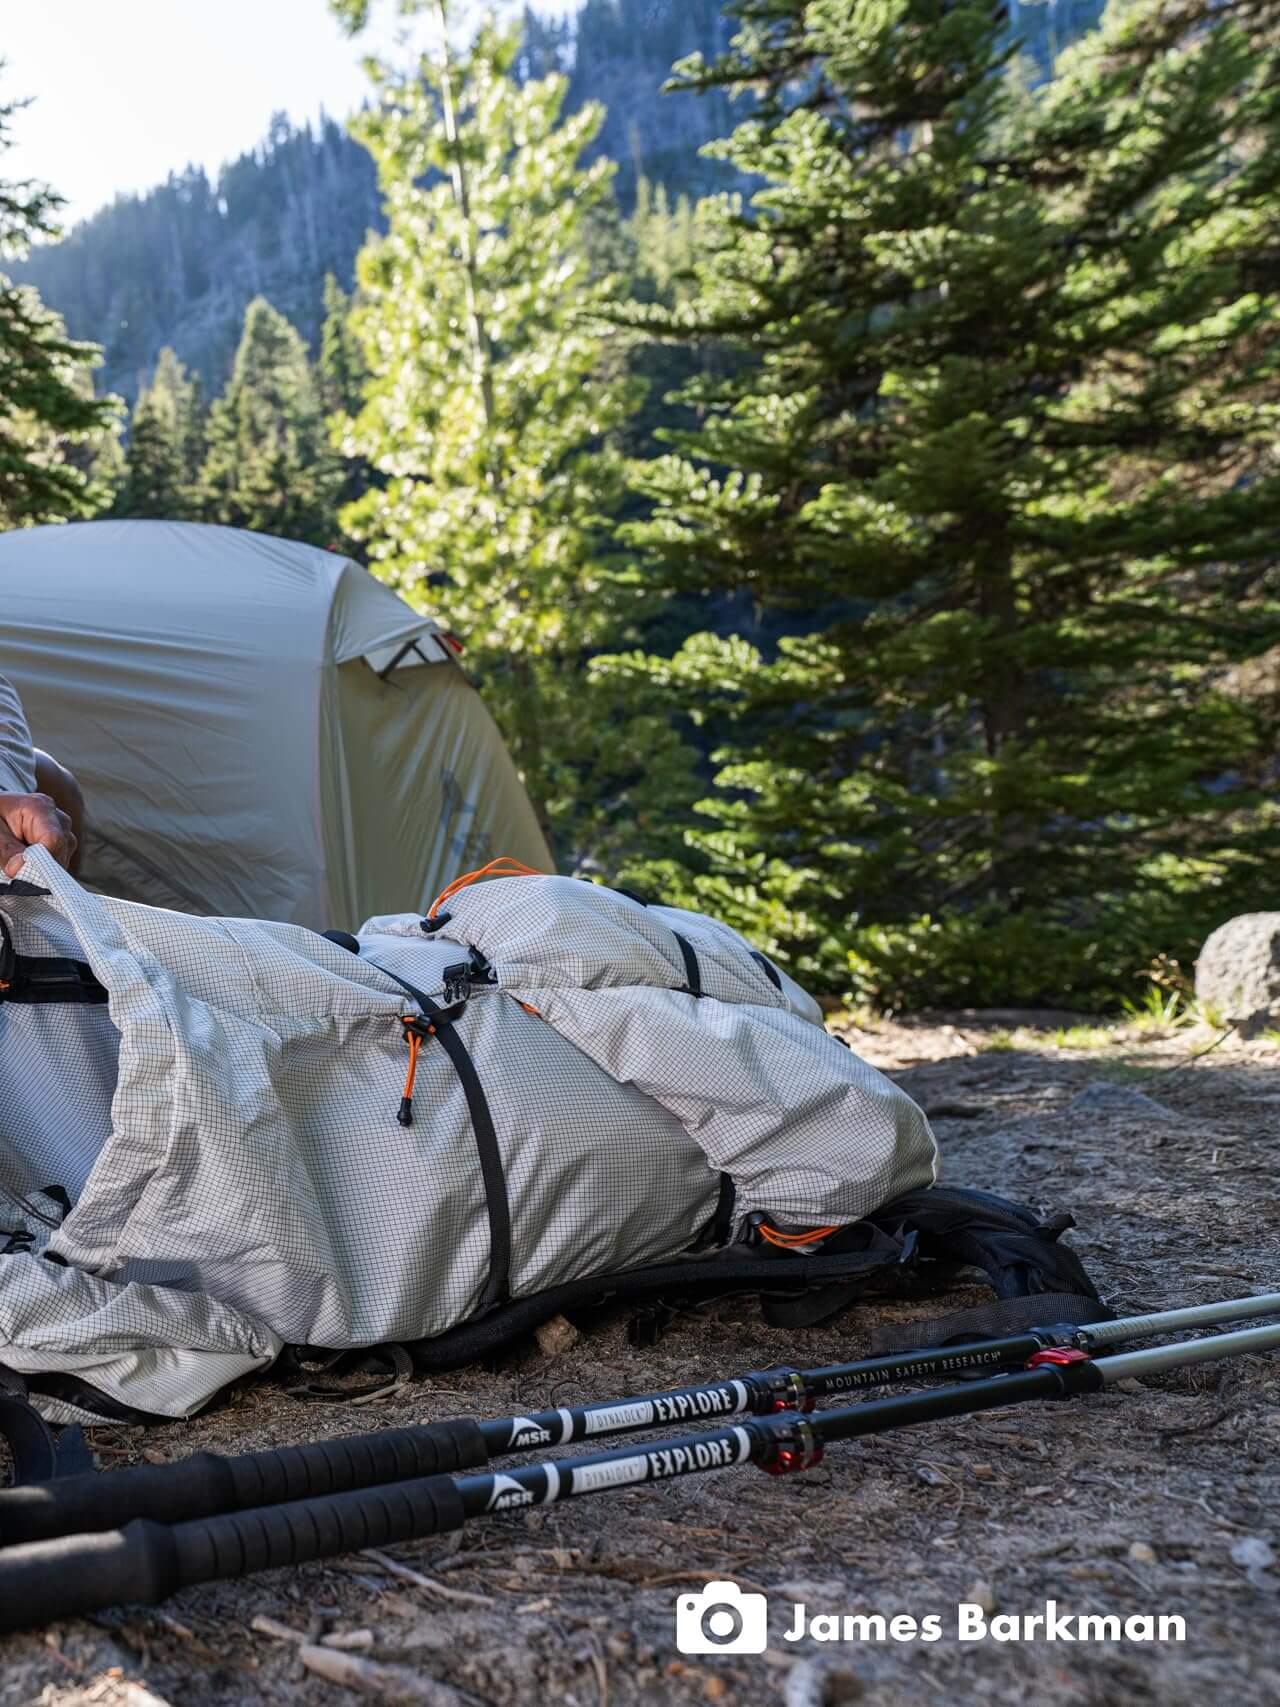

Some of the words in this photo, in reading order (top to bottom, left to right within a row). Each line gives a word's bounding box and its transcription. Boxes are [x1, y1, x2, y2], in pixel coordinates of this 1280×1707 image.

[825, 1368, 889, 1390] MOUNTAIN
[895, 1361, 936, 1377] SAFETY
[516, 1429, 551, 1447] MSR
[653, 1388, 732, 1421] EXPLORE
[495, 1490, 535, 1510] MSR
[649, 1439, 733, 1478] EXPLORE
